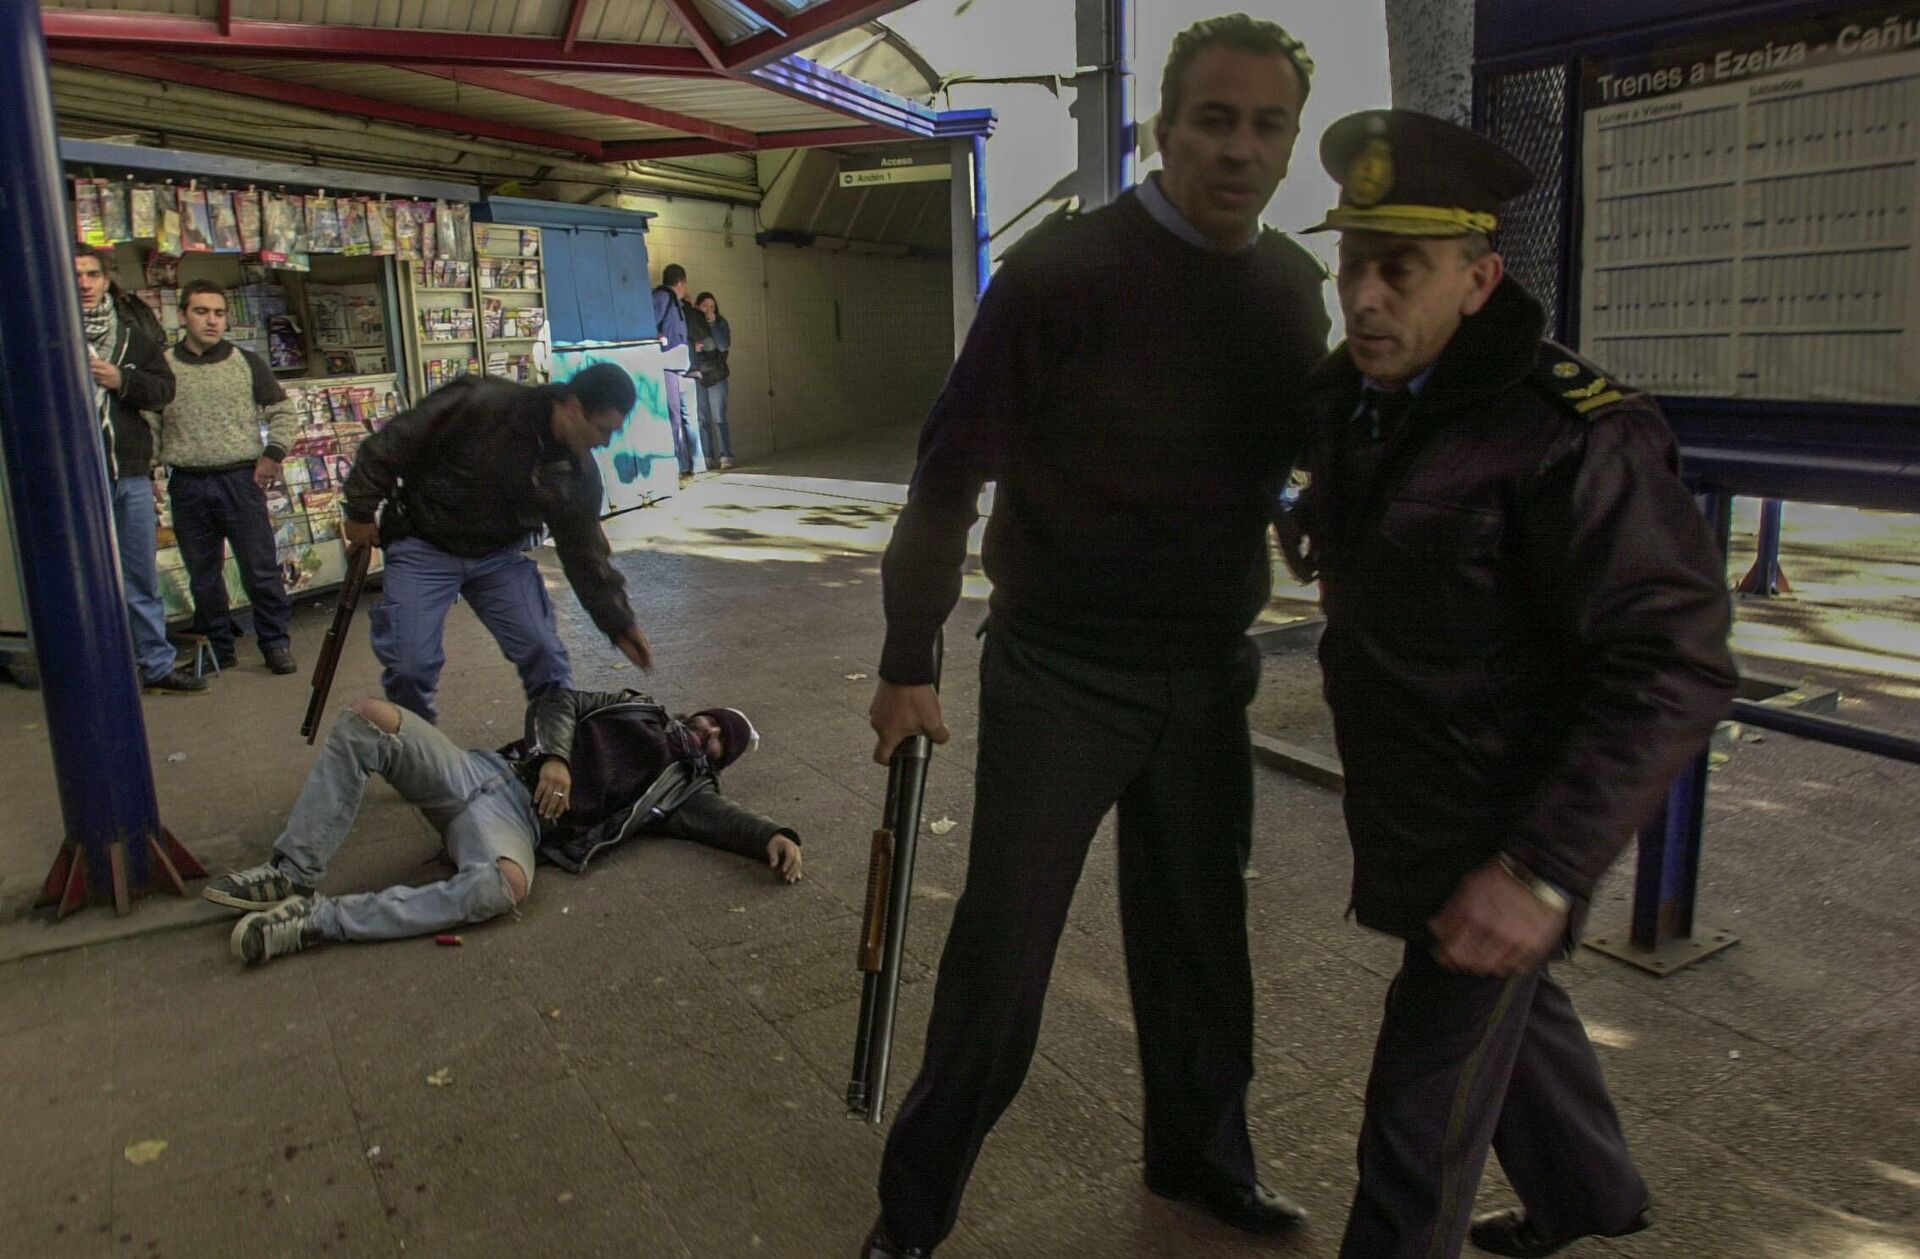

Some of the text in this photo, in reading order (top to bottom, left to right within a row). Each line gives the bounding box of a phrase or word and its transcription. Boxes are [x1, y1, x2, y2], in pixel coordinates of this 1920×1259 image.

[1597, 67, 1682, 101] Trenes
[1690, 65, 1704, 83] a
[1714, 42, 1806, 79] Ezeiza
[881, 157, 913, 166] Acceso
